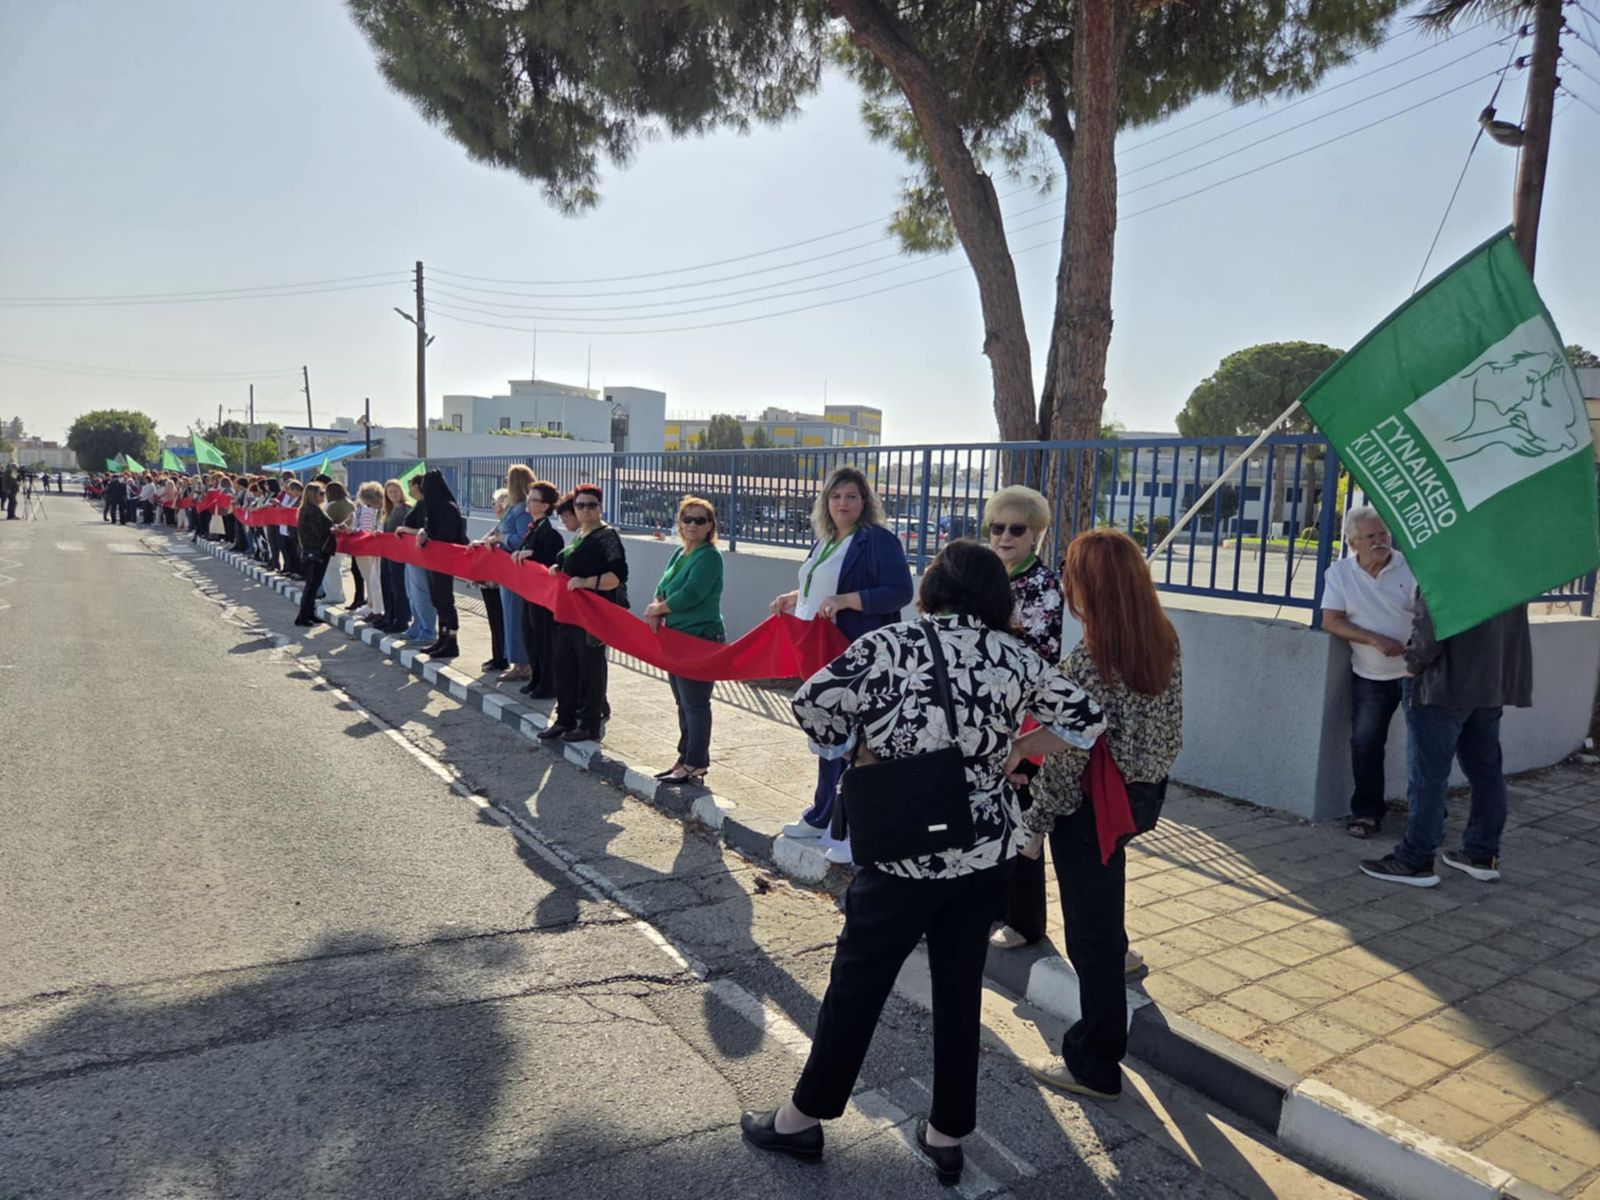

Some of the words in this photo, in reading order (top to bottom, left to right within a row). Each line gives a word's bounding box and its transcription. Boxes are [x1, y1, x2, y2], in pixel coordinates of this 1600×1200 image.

[1352, 433, 1411, 504] ΚΙΝΗΜΑ
[1402, 503, 1432, 544] ΠΟΓΟ
[1377, 416, 1457, 528] ΓΥΝΑΙΚΕΙΟ
